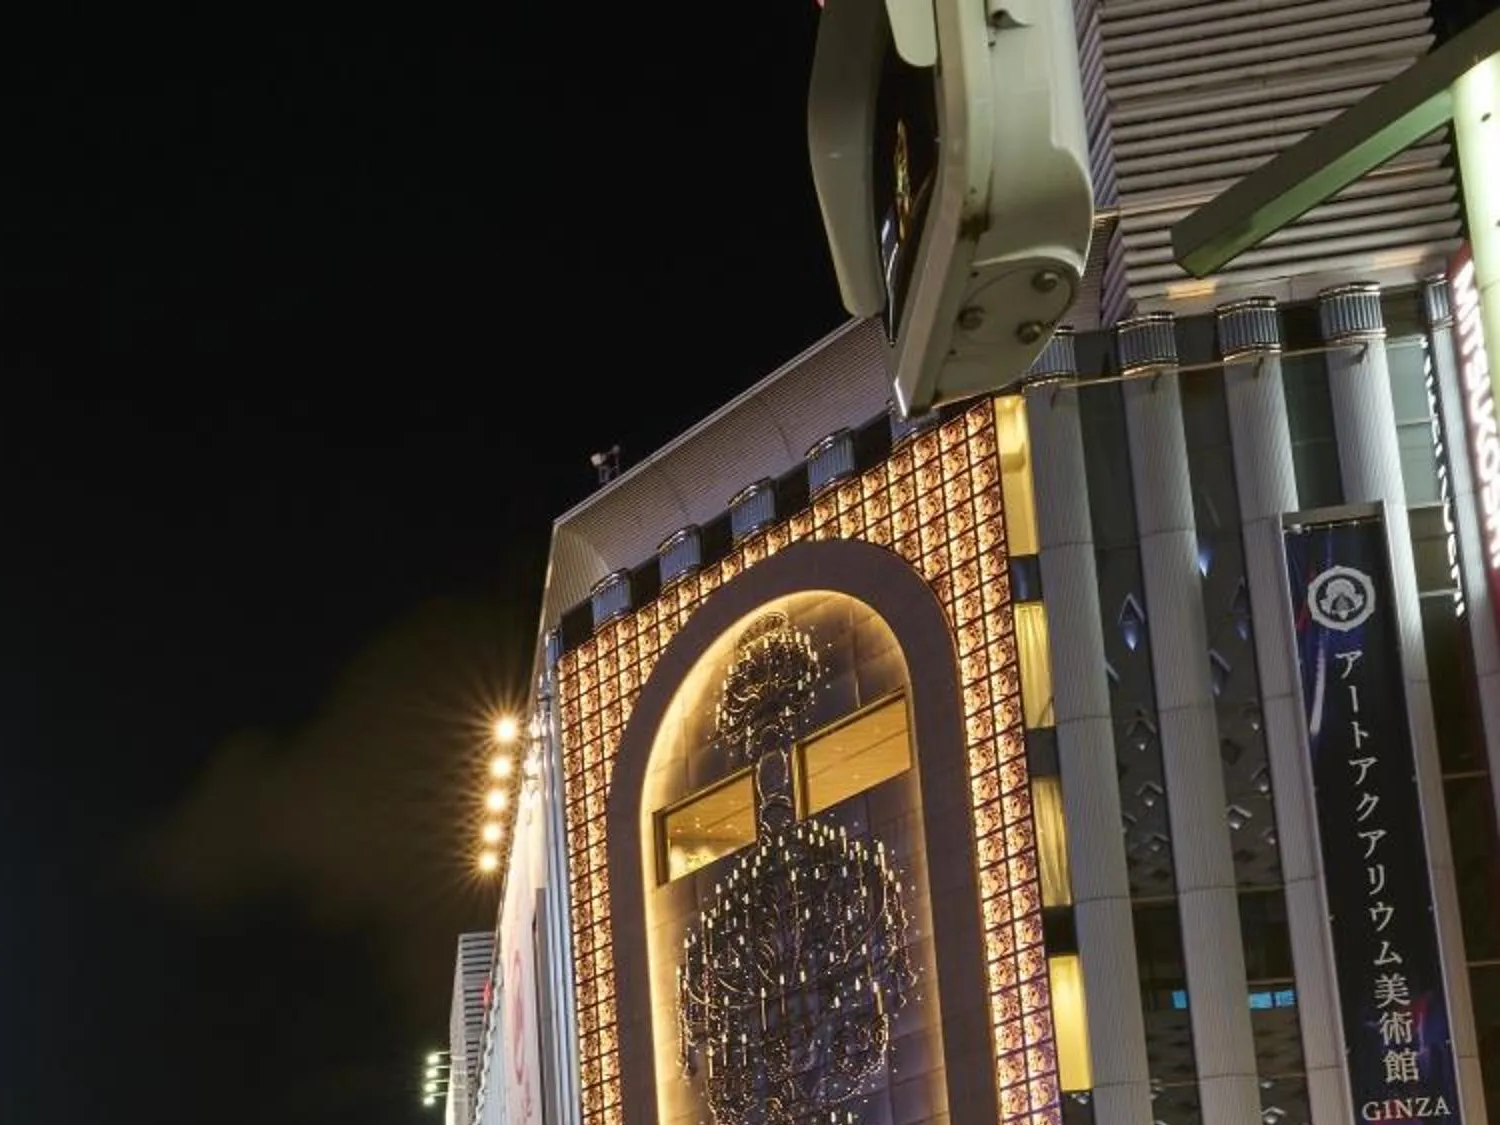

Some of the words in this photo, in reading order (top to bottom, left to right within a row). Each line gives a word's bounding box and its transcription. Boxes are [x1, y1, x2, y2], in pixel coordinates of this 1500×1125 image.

[1334, 650, 1419, 1084] アートアクアリウム美術館
[1361, 1096, 1451, 1122] GINZA
